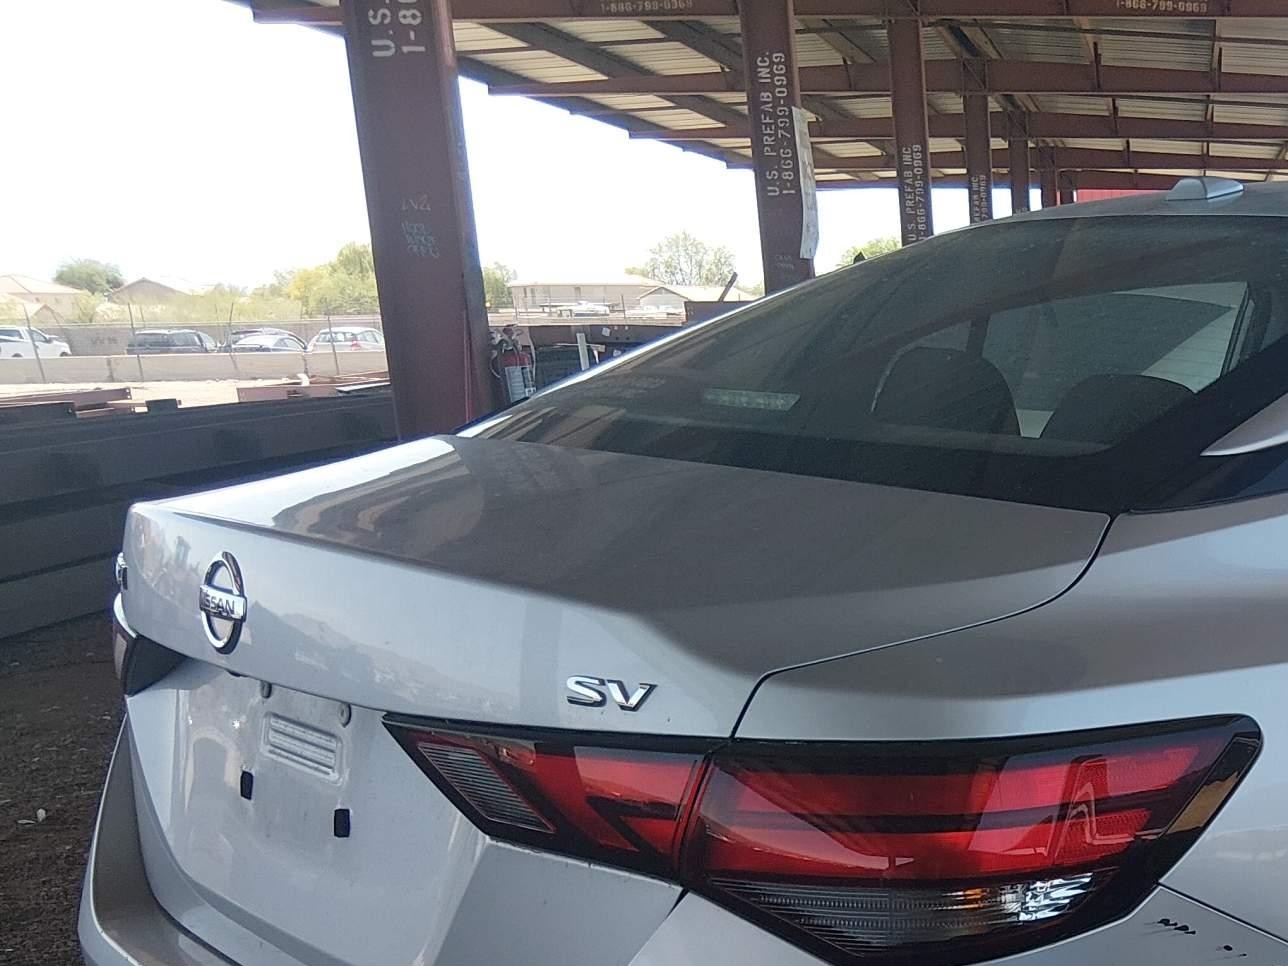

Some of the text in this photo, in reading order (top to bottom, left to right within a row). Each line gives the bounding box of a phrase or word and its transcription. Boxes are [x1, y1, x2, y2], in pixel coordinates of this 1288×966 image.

[756, 51, 780, 196] U.S. PREFAB INC.
[772, 52, 796, 194] 1-866-799-0969
[904, 170, 916, 214] PREFAB
[566, 675, 658, 712] SV
